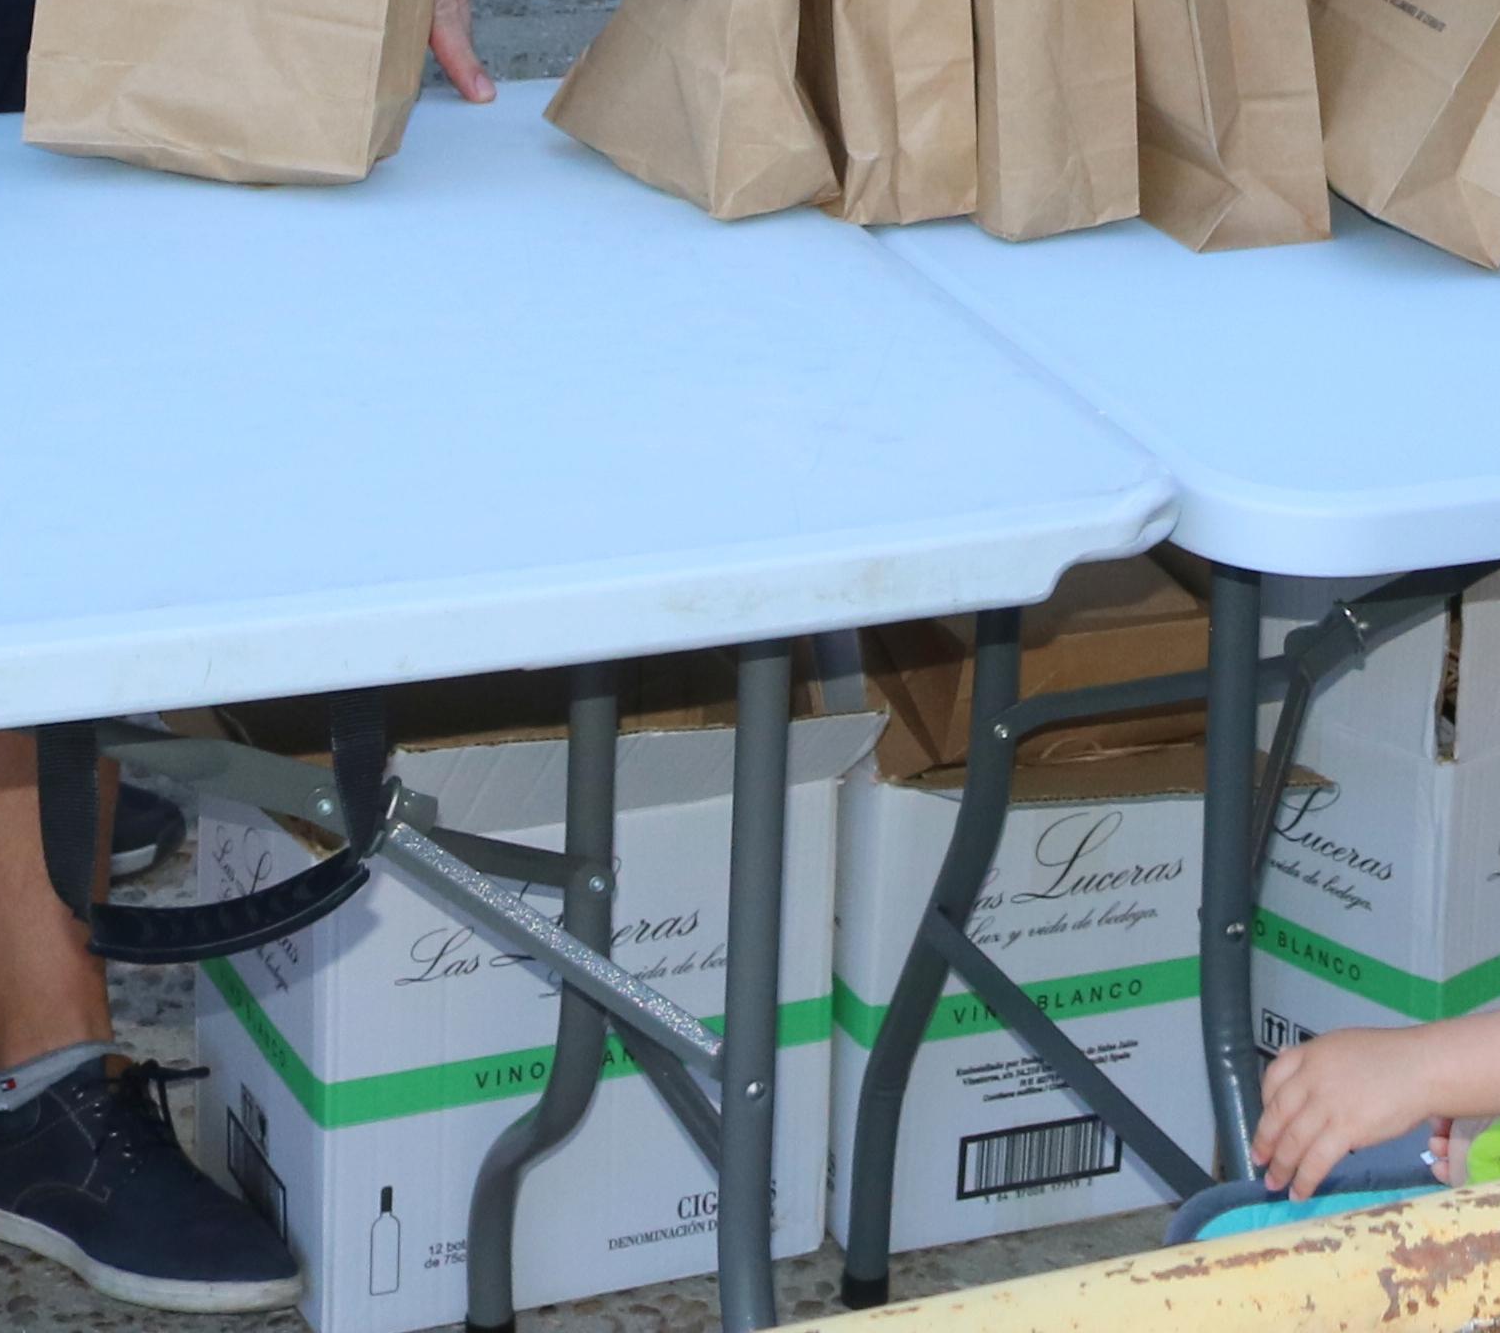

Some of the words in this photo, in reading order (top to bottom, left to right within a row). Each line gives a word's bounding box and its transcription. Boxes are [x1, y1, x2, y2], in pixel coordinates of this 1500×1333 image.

[1010, 810, 1184, 904] Luceras
[1071, 908, 1095, 930] de
[394, 925, 480, 986] Las
[1277, 930, 1362, 983] BLANCO
[953, 1002, 999, 1025] VIN
[1036, 979, 1143, 1011] BLANCO
[475, 1062, 546, 1090] VINO
[428, 1242, 444, 1256] 12
[607, 1221, 706, 1252] DENOMINACIÓN
[706, 1219, 719, 1235] D
[424, 1257, 441, 1270] de
